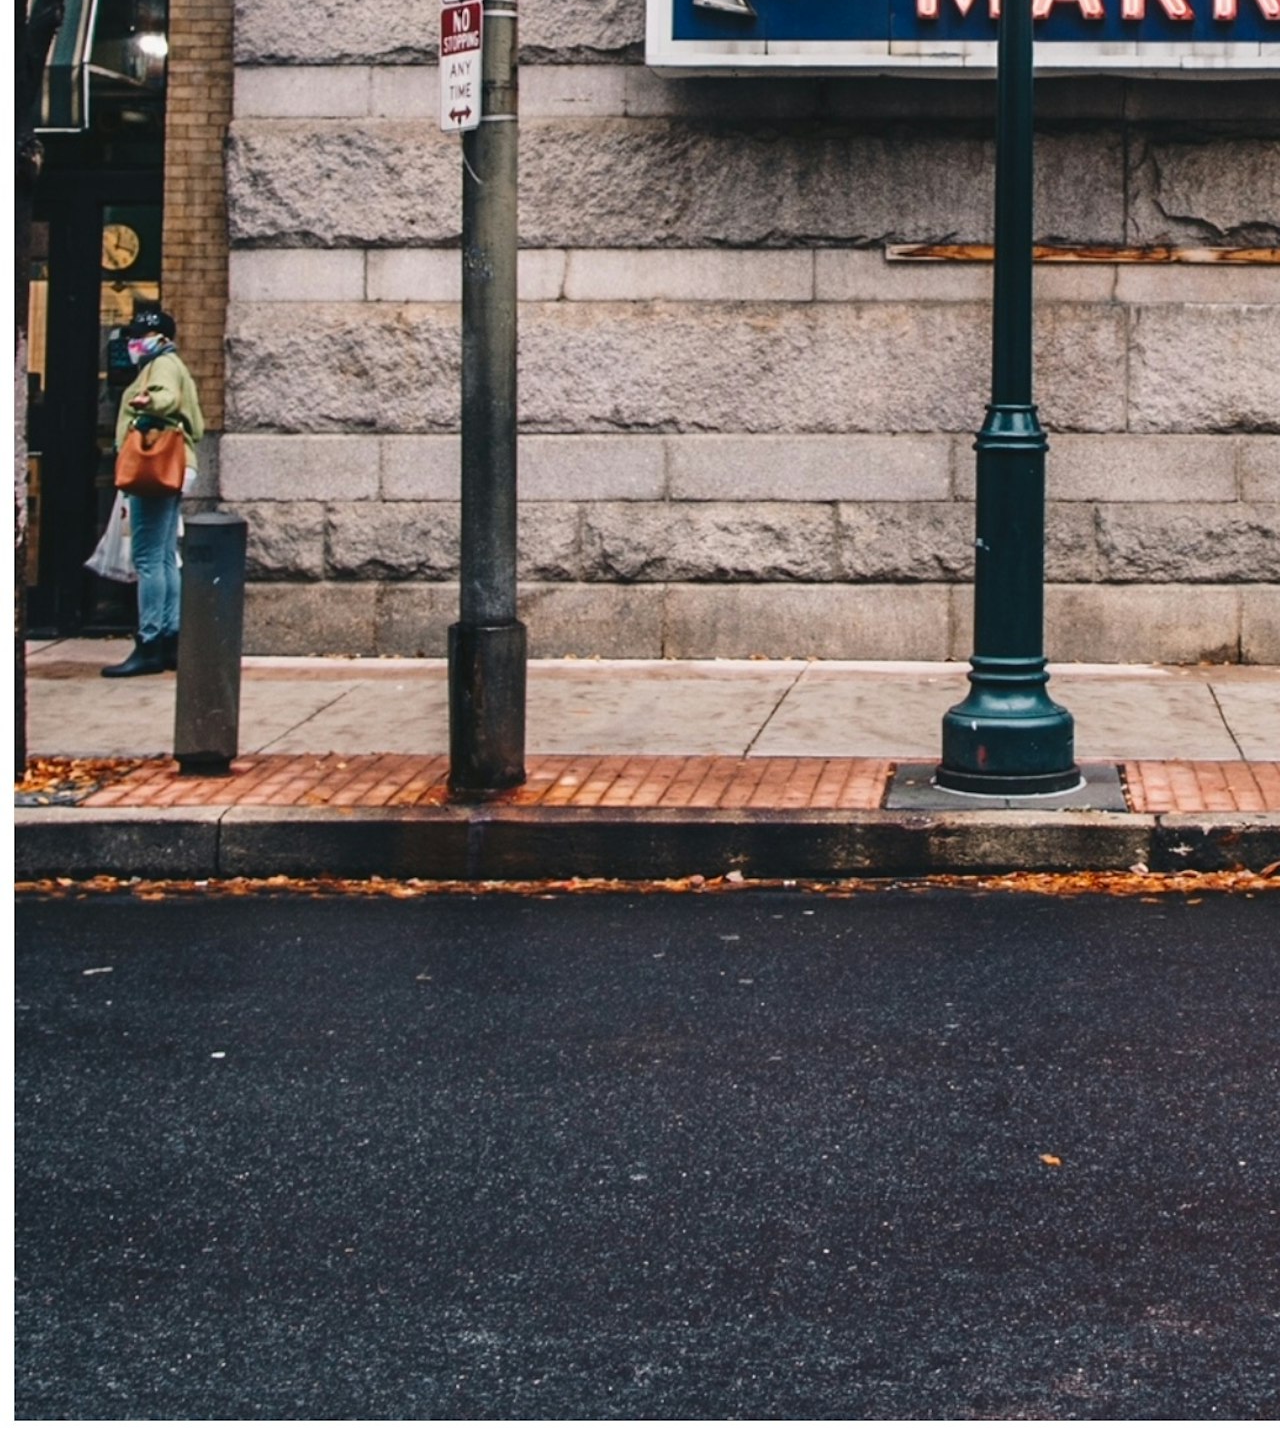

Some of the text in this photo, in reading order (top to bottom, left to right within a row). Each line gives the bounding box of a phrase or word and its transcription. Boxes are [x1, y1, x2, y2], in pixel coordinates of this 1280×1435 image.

[453, 7, 470, 32] NO
[443, 31, 479, 53] STOPPING
[450, 60, 472, 79] ANY
[450, 83, 471, 101] TIME
